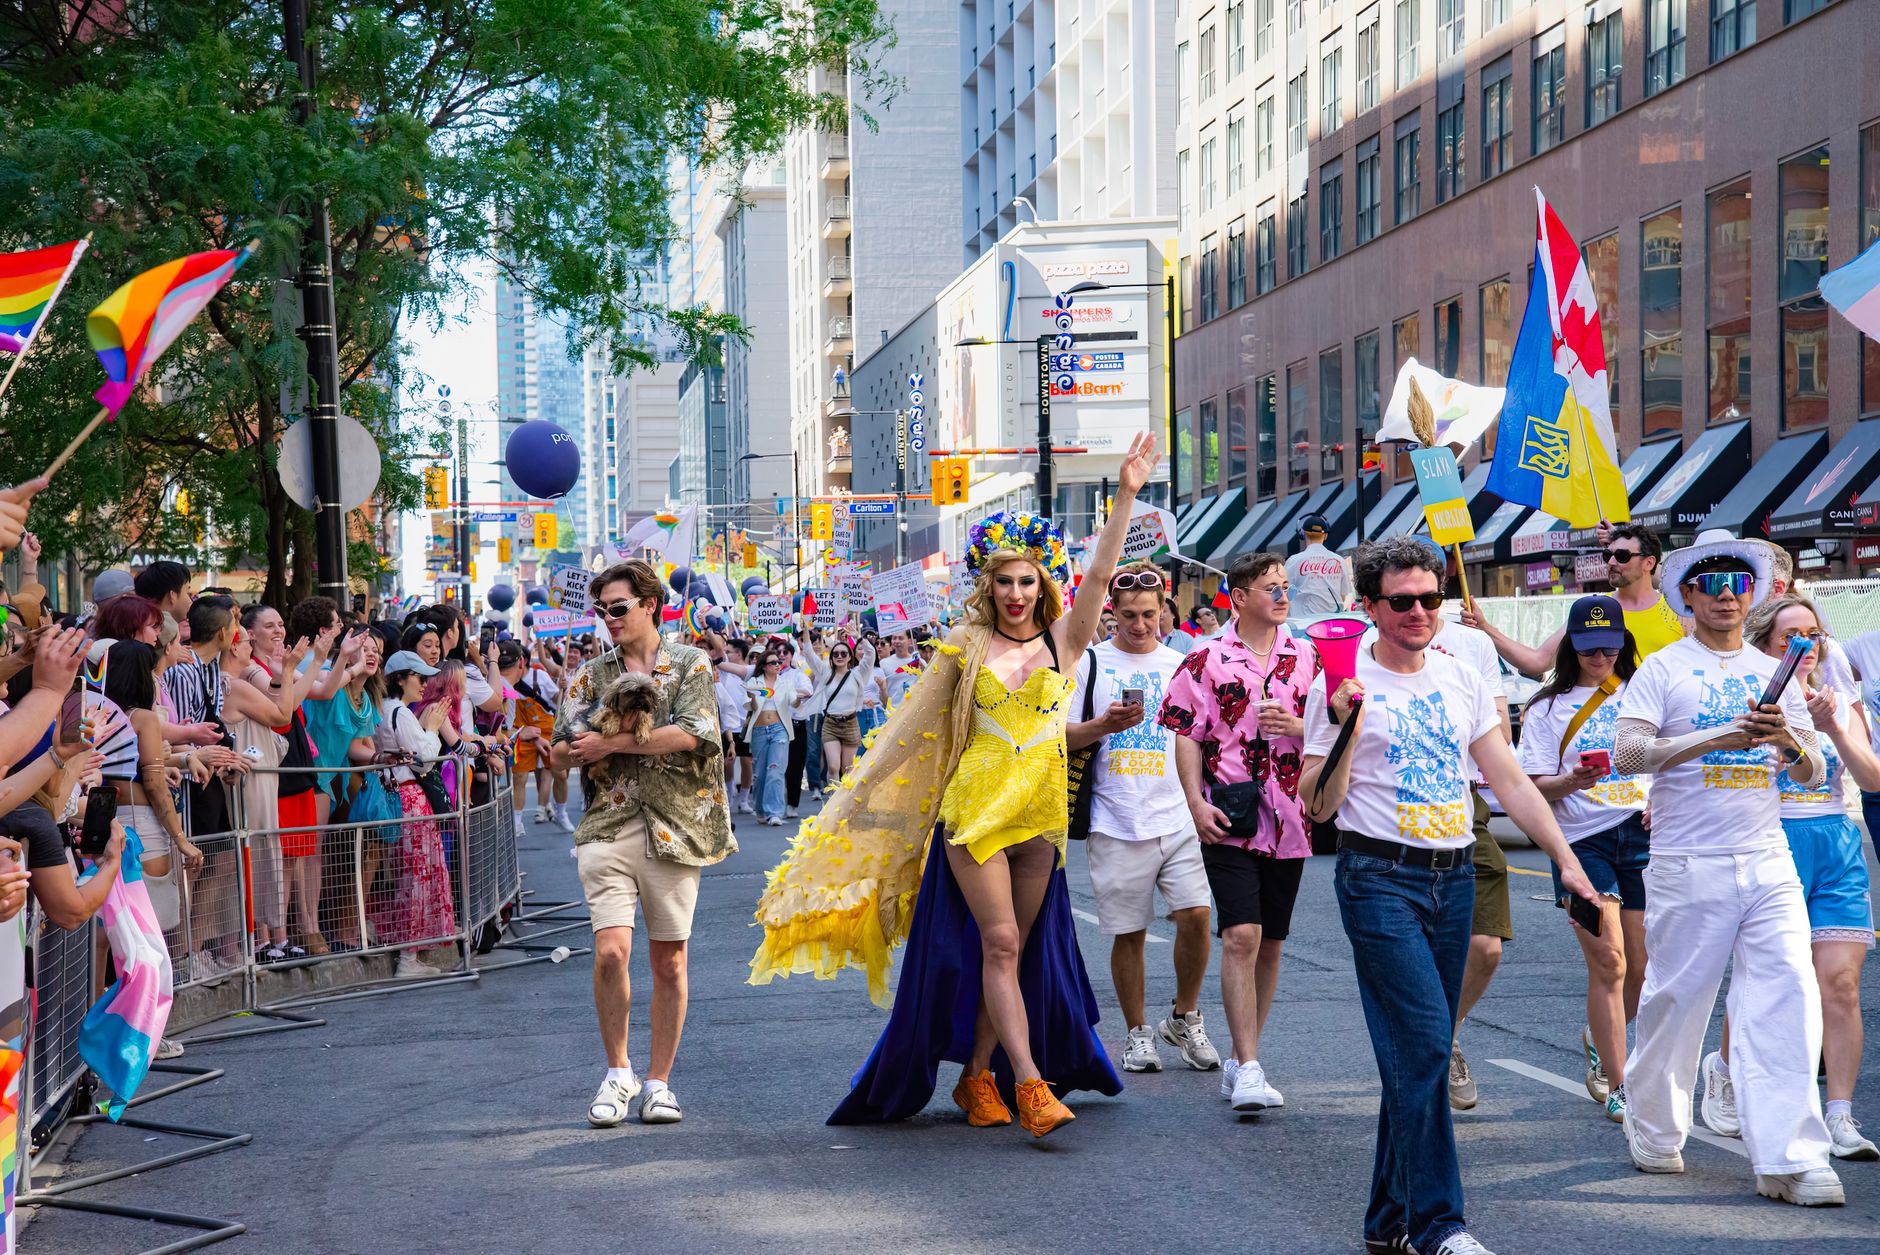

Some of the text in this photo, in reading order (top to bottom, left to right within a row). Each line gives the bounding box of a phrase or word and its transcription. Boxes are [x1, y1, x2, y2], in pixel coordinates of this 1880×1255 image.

[1041, 306, 1113, 318] SHPPERS
[1041, 344, 1049, 415] DOWNTOWN
[855, 504, 882, 512] Carlton
[1124, 533, 1146, 545] OUD
[1124, 540, 1156, 554] PROUD
[1576, 554, 1603, 568] CURREN
[1576, 568, 1608, 580] EXCHANG
[566, 581, 585, 591] KICK
[564, 589, 585, 600] WITH
[561, 598, 585, 610] PRIDE
[1108, 750, 1166, 760] FREEDOM
[1109, 759, 1164, 768] IS OUR
[1108, 767, 1165, 777] TRADITION
[1396, 803, 1465, 816] FREEDOM
[1399, 815, 1419, 827] IS
